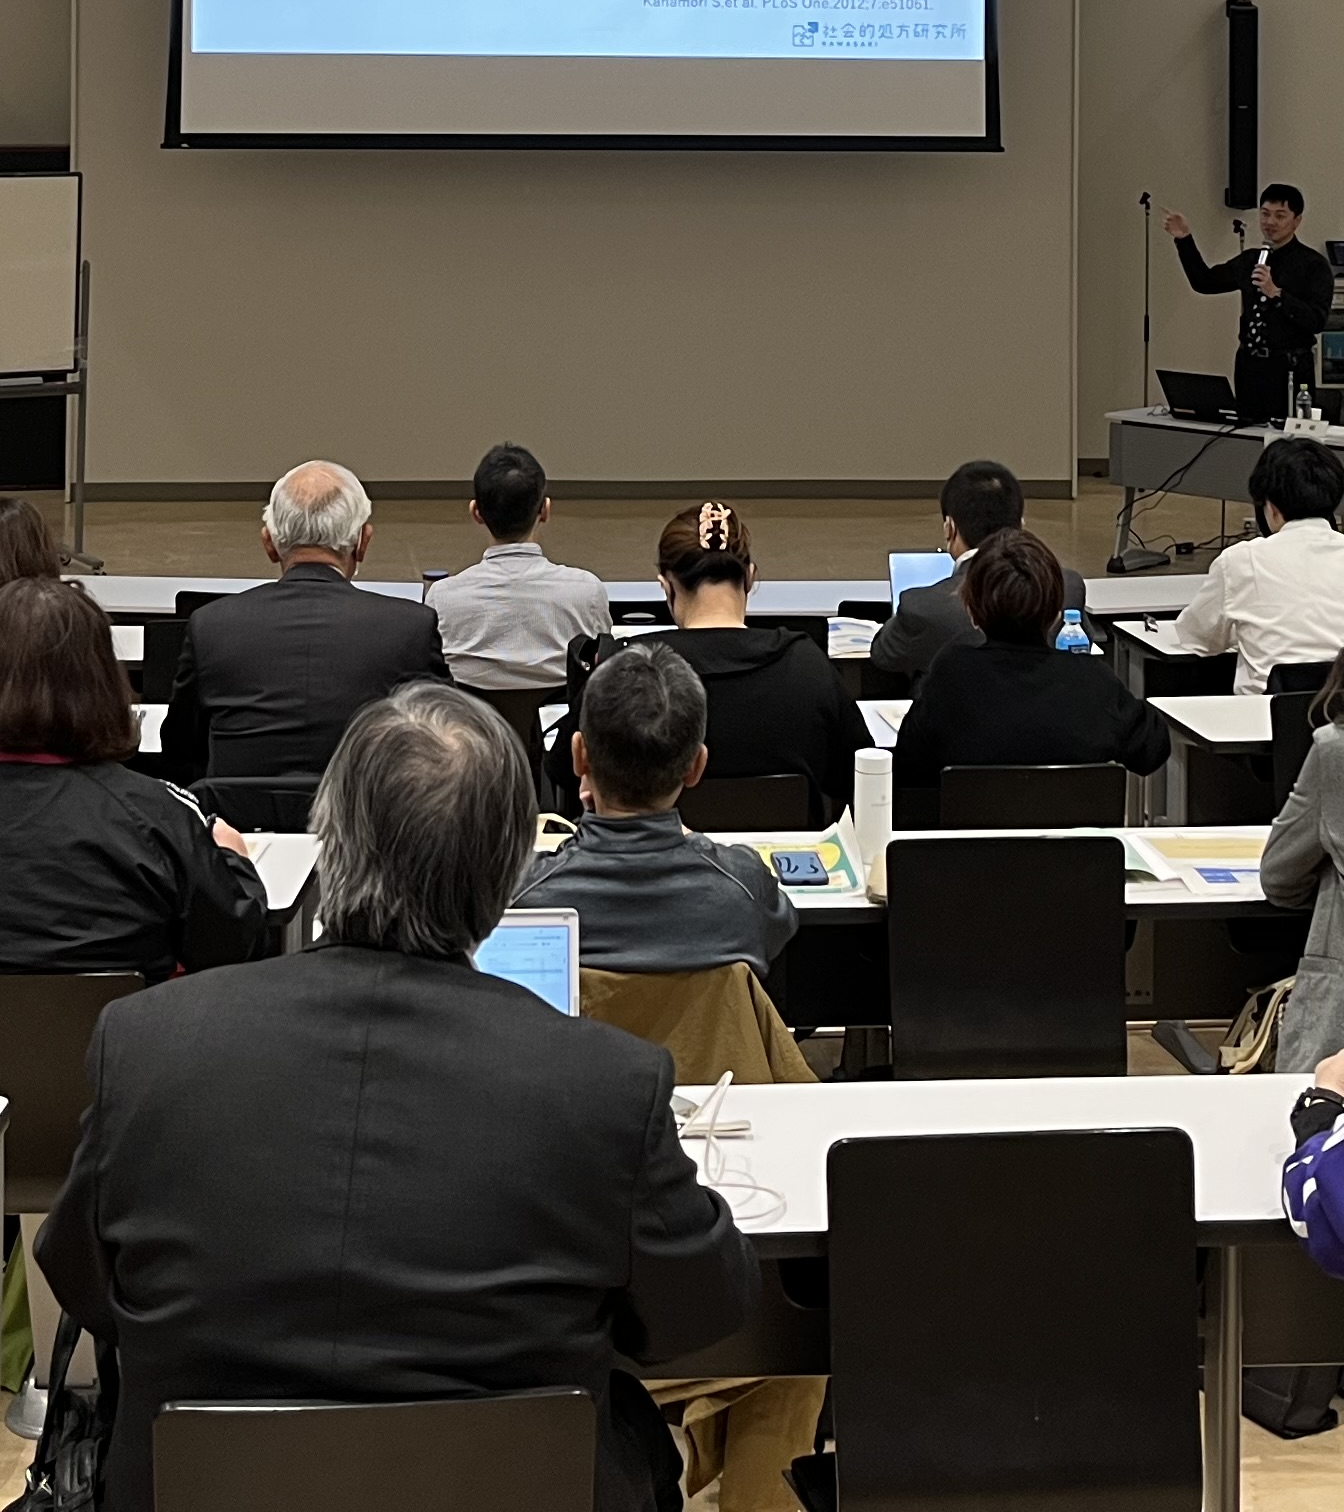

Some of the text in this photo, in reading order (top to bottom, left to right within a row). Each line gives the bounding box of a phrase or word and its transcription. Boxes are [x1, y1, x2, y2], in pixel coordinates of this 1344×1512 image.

[823, 23, 967, 40] 社会的処方研究所
